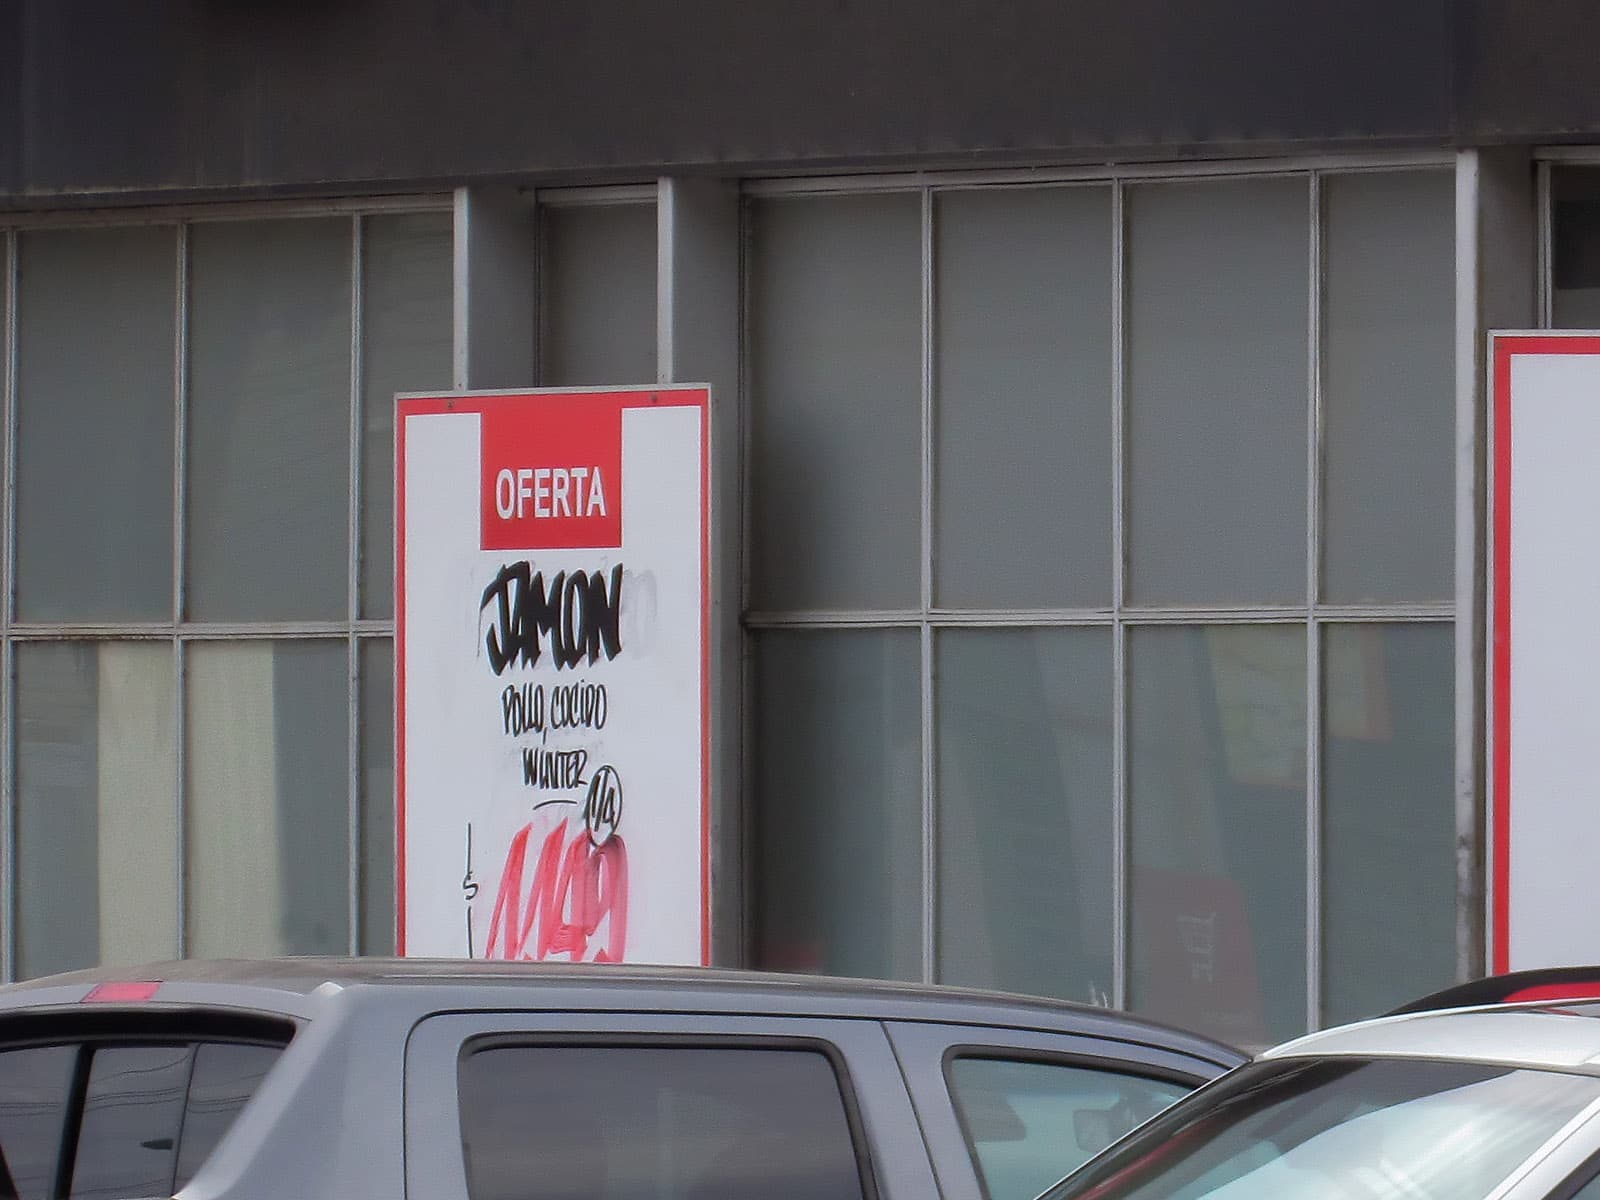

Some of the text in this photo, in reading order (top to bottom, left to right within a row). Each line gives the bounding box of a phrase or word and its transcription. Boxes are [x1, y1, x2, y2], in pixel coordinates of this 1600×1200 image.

[496, 466, 606, 519] OFERTA
[479, 560, 623, 676] JAMON
[522, 748, 587, 789] WINTER
